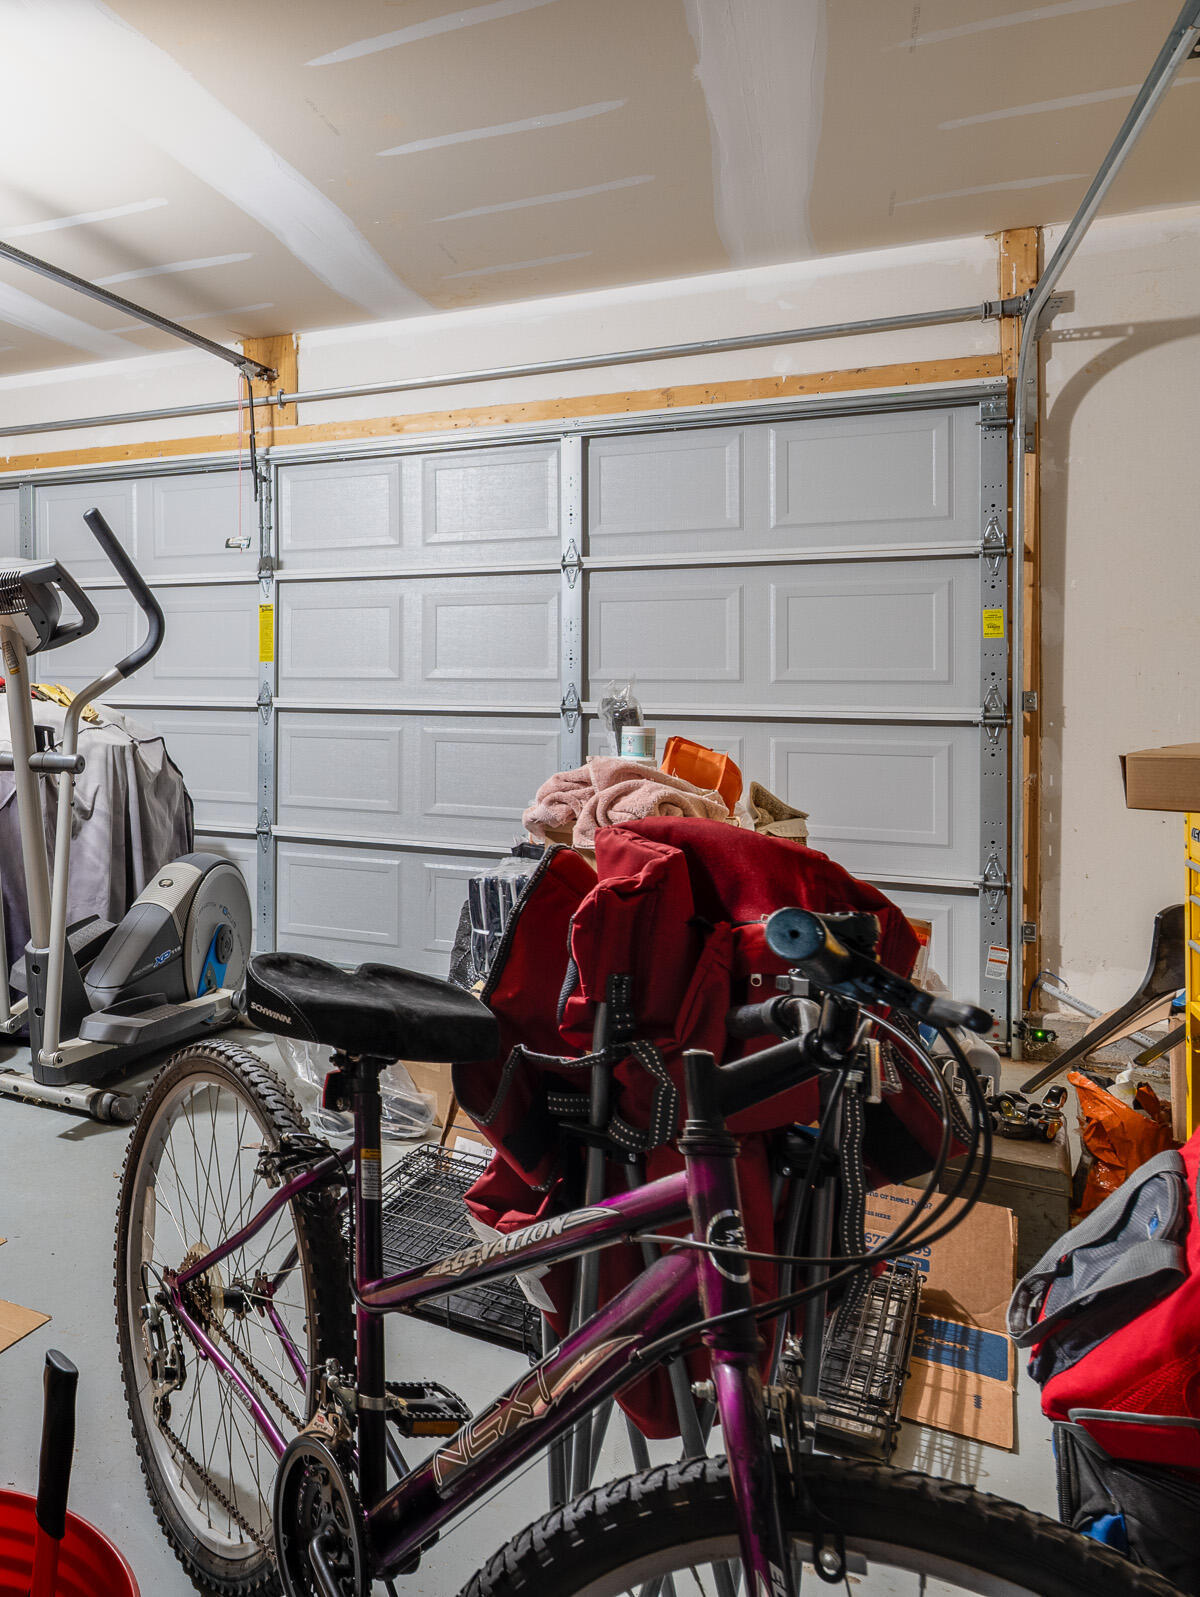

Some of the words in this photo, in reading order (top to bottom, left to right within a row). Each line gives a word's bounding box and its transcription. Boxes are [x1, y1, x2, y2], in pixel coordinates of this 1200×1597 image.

[250, 1001, 291, 1024] SCHWINN
[890, 1195, 910, 1205] need
[437, 1213, 569, 1275] ELEVATION
[432, 1346, 561, 1487] NEXT
